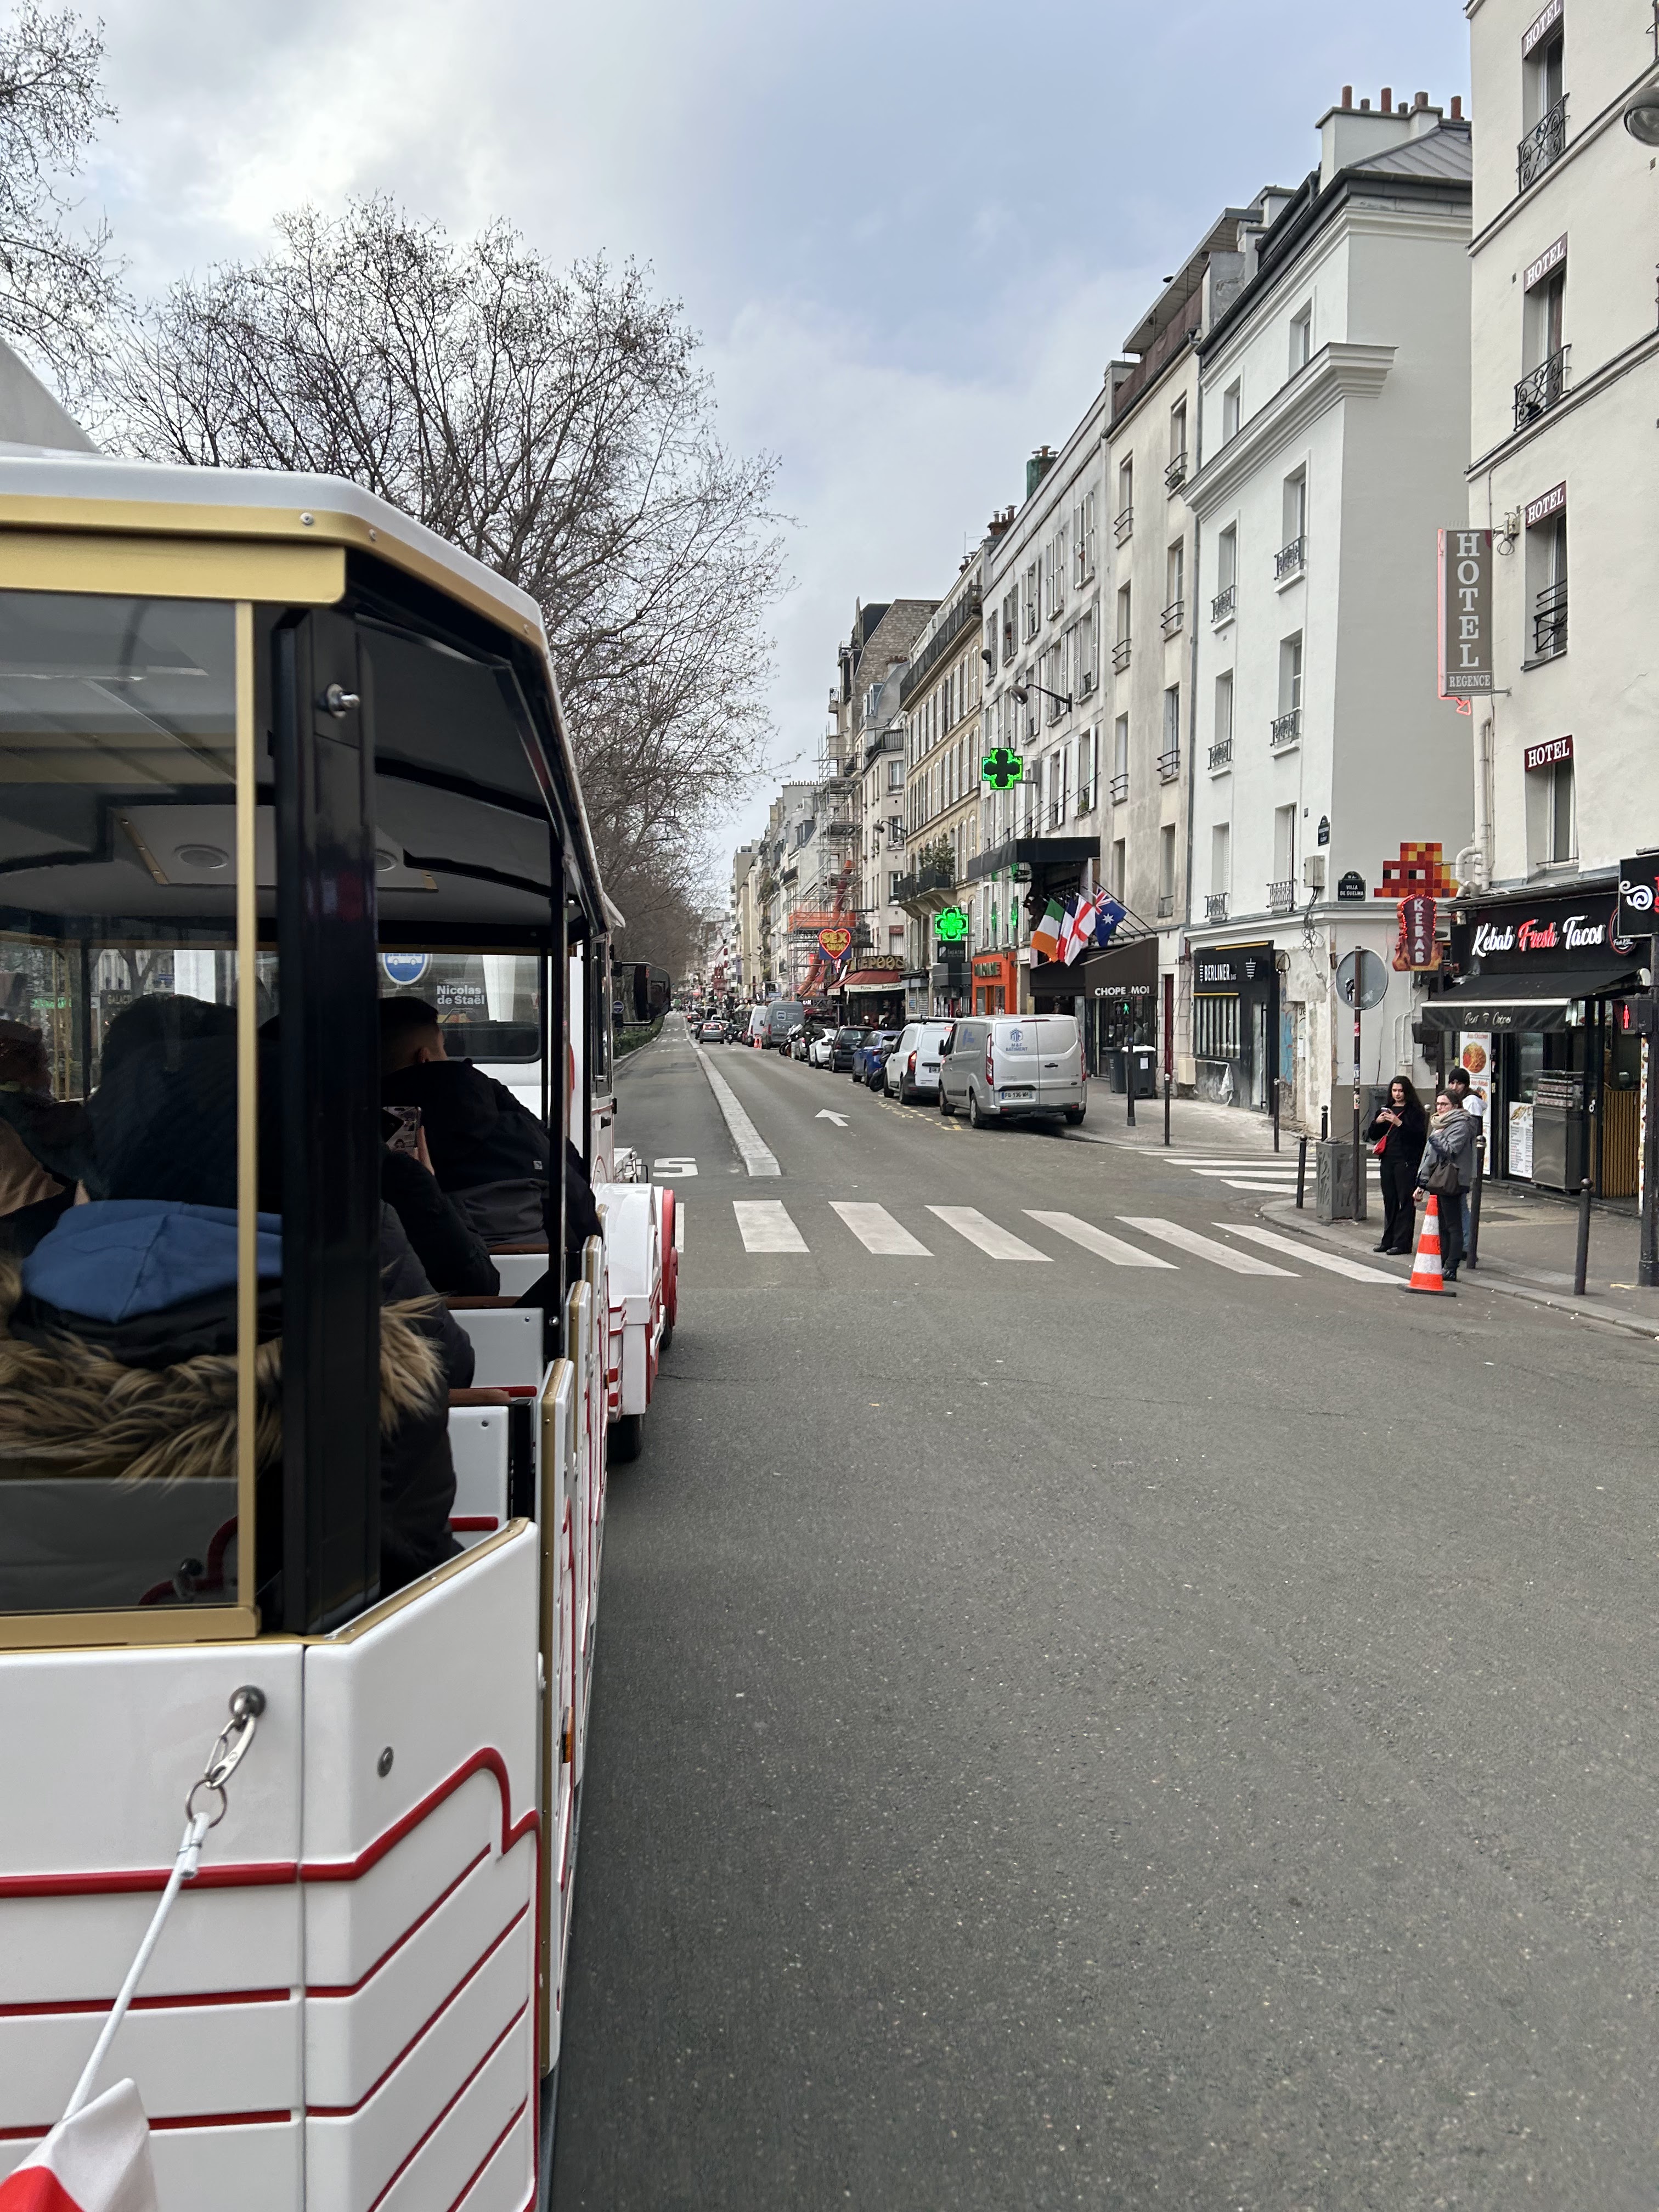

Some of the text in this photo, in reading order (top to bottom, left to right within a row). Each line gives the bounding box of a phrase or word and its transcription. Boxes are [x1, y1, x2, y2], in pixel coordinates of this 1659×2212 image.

[1525, 1, 1561, 52] HOTEL
[1527, 241, 1565, 286] HOTEL
[1528, 487, 1564, 525] HOTEL
[1457, 533, 1480, 667] HOTEL
[1449, 674, 1491, 689] REGENCE
[1528, 739, 1570, 768] HOTEL
[821, 932, 848, 944] SEX
[1414, 899, 1425, 963] KEBAB
[1471, 915, 1605, 957] Kebab Fresh Tacos
[1204, 963, 1230, 981] BERLINER
[437, 985, 482, 995] Nicolas
[437, 995, 484, 1005] de Staël
[1094, 985, 1150, 996] CHOPE MOI
